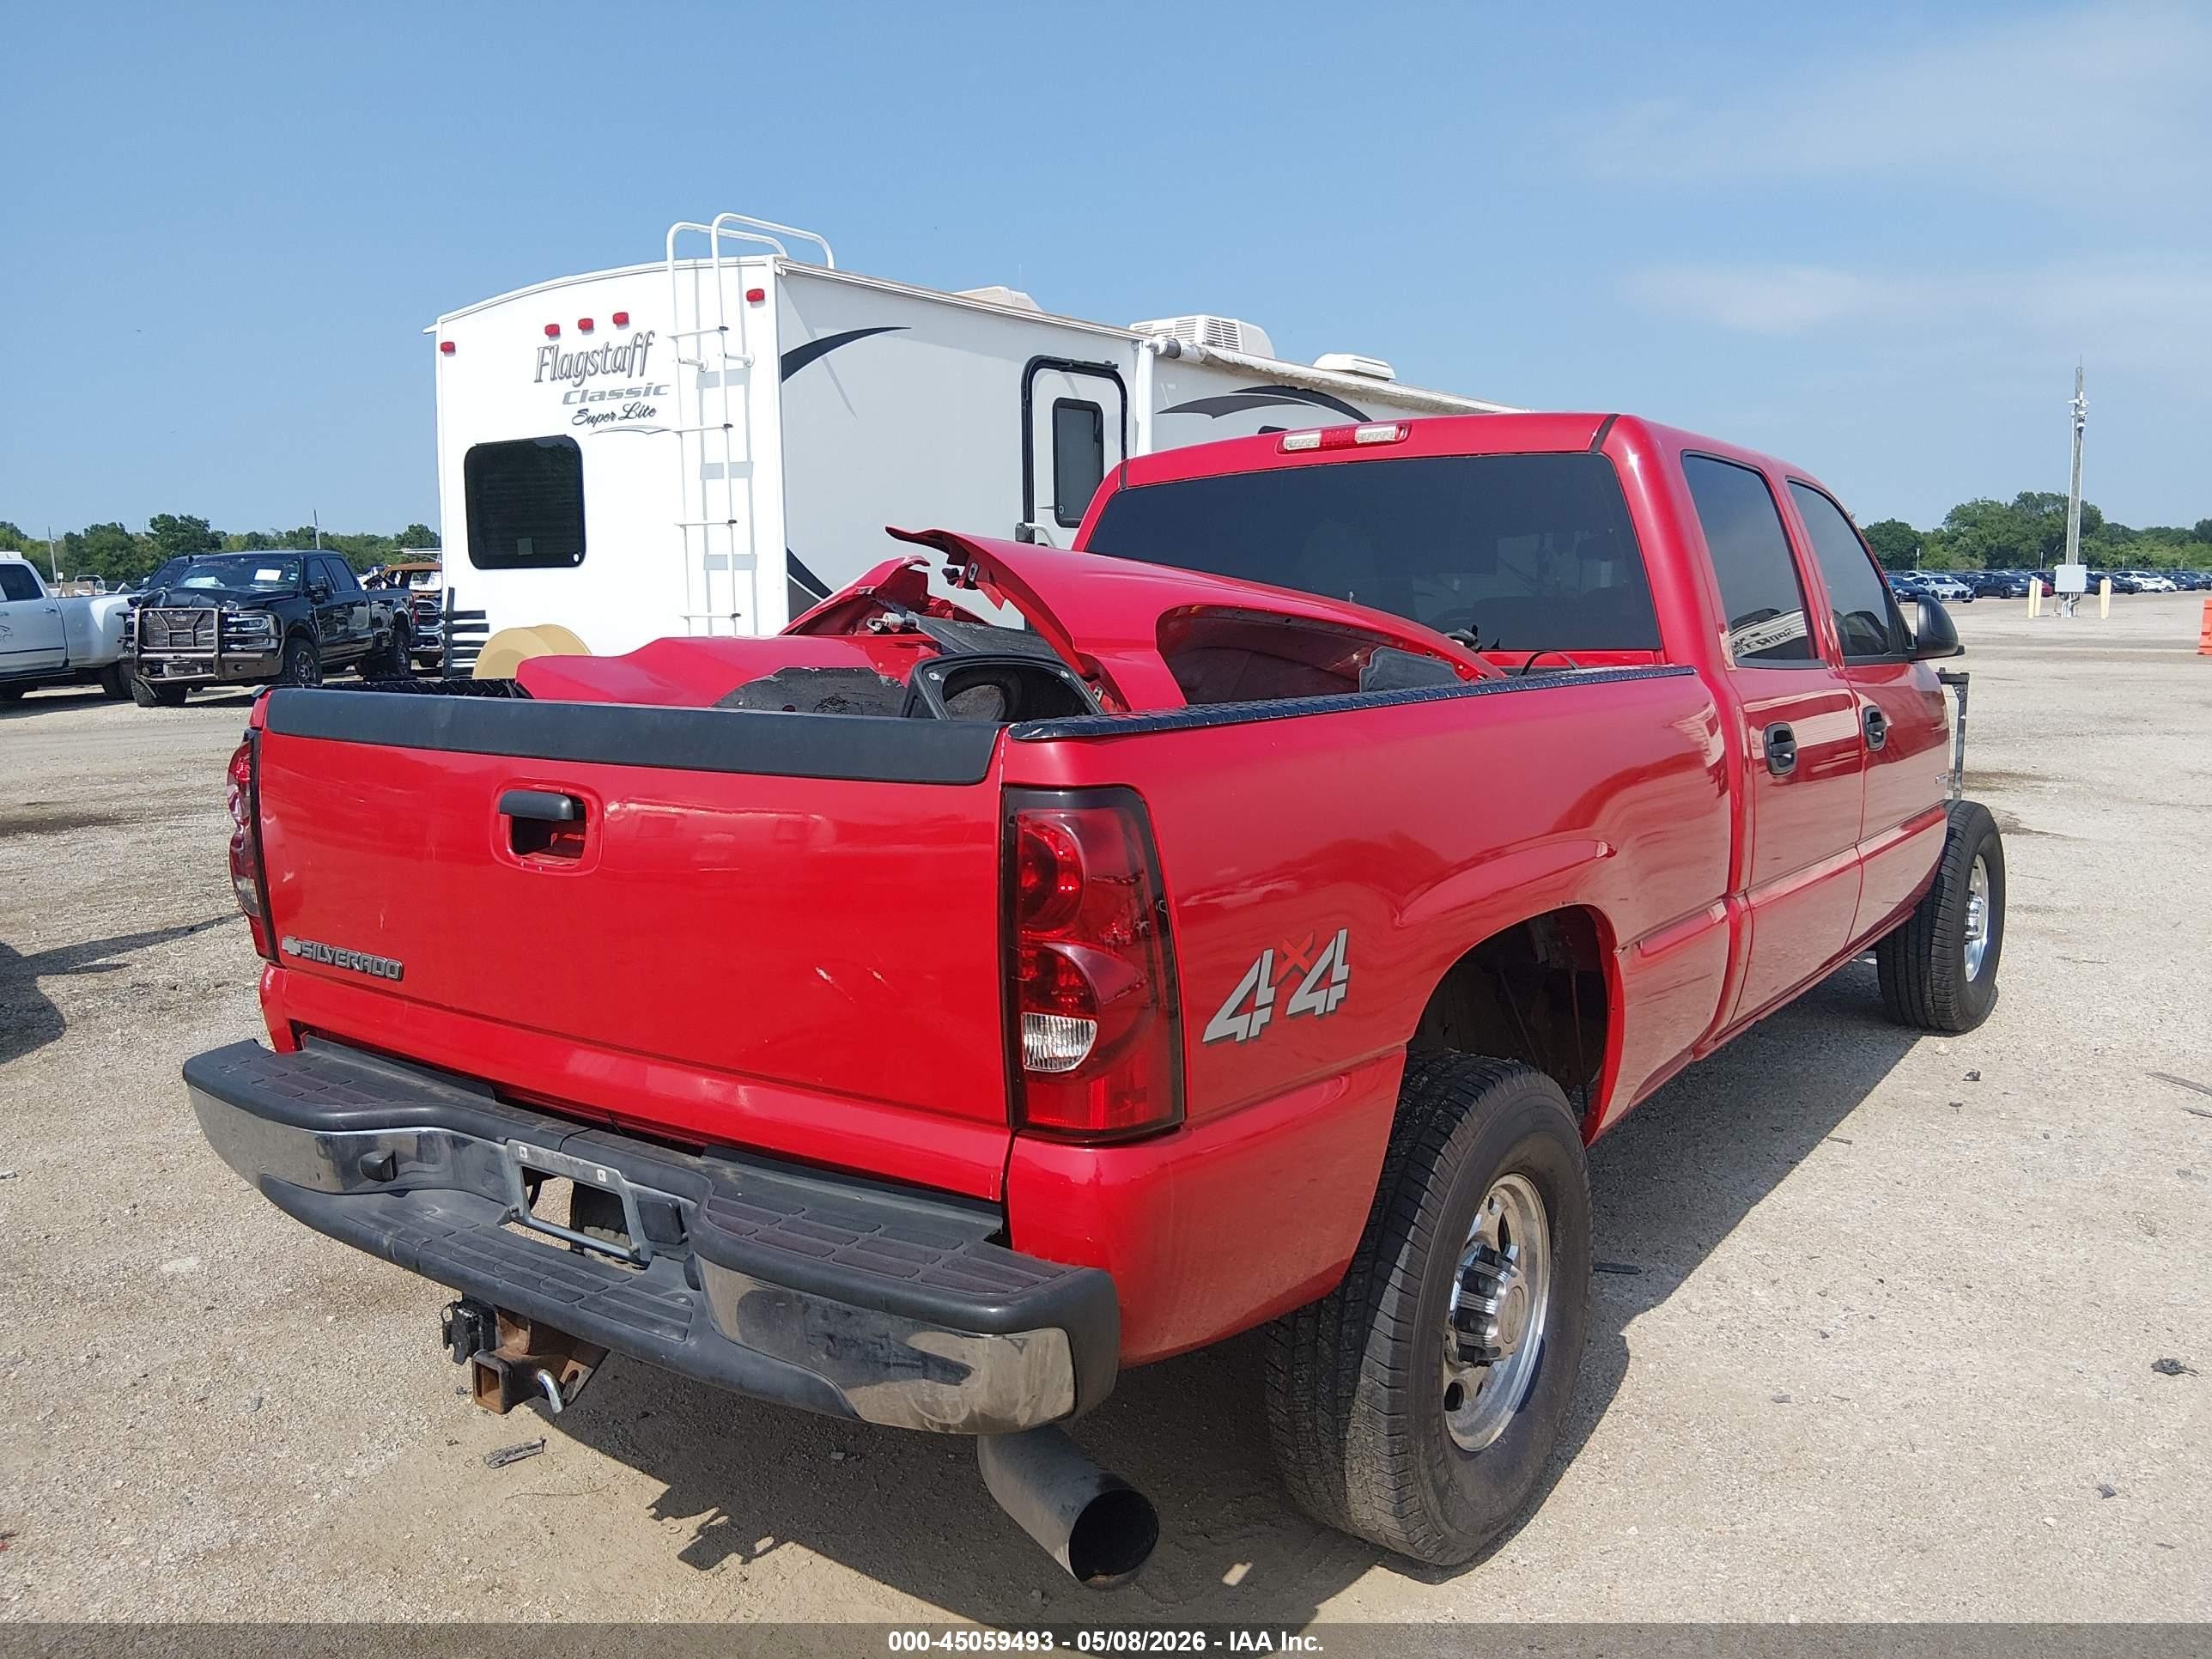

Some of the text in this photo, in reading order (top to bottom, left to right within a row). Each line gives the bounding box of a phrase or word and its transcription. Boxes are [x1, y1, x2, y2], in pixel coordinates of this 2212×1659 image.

[533, 330, 655, 387] Flagstaff
[562, 382, 671, 405] Classic
[571, 401, 657, 428] Super Lite
[301, 939, 404, 981] SILVERADO
